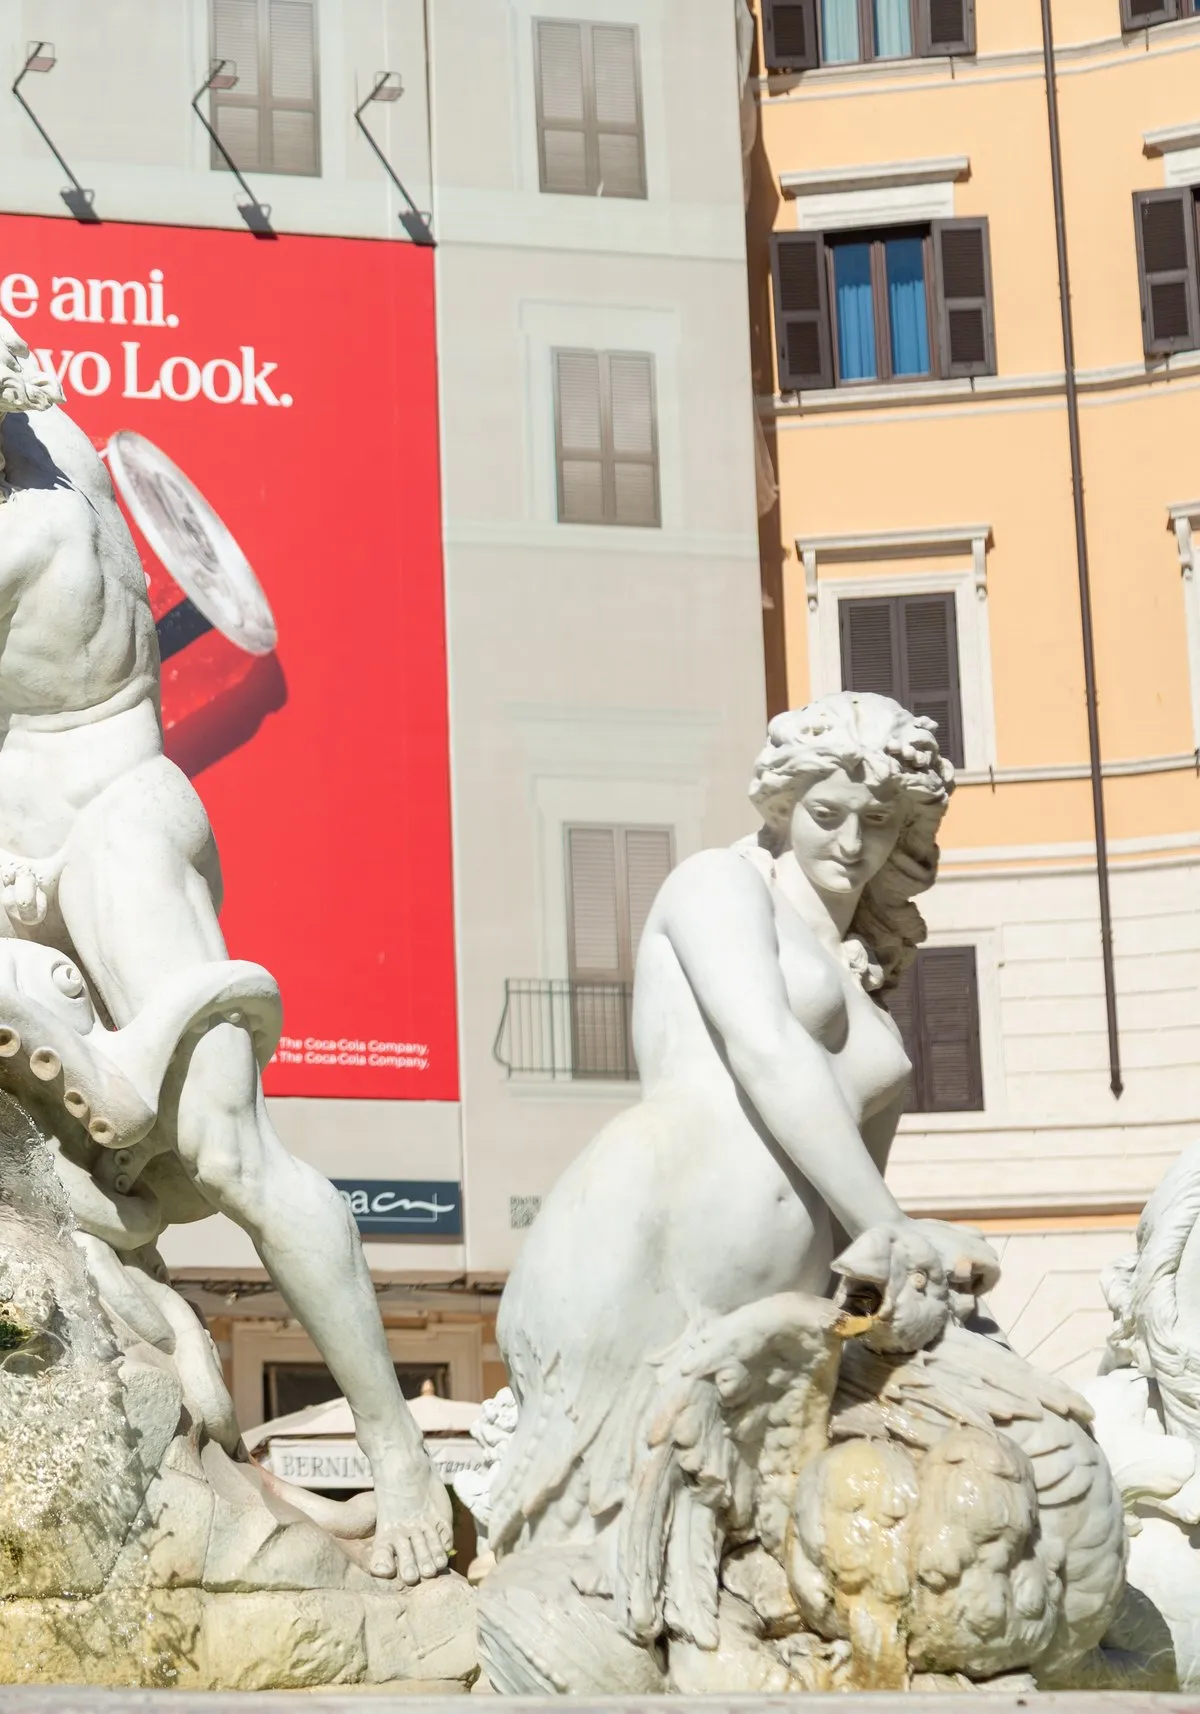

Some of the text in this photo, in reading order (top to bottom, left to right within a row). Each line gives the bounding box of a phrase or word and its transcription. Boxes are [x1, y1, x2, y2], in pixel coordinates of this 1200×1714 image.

[50, 269, 180, 328] ami.
[121, 341, 294, 407] Look.
[279, 1050, 303, 1064] The
[281, 1456, 374, 1477] BERNIN
